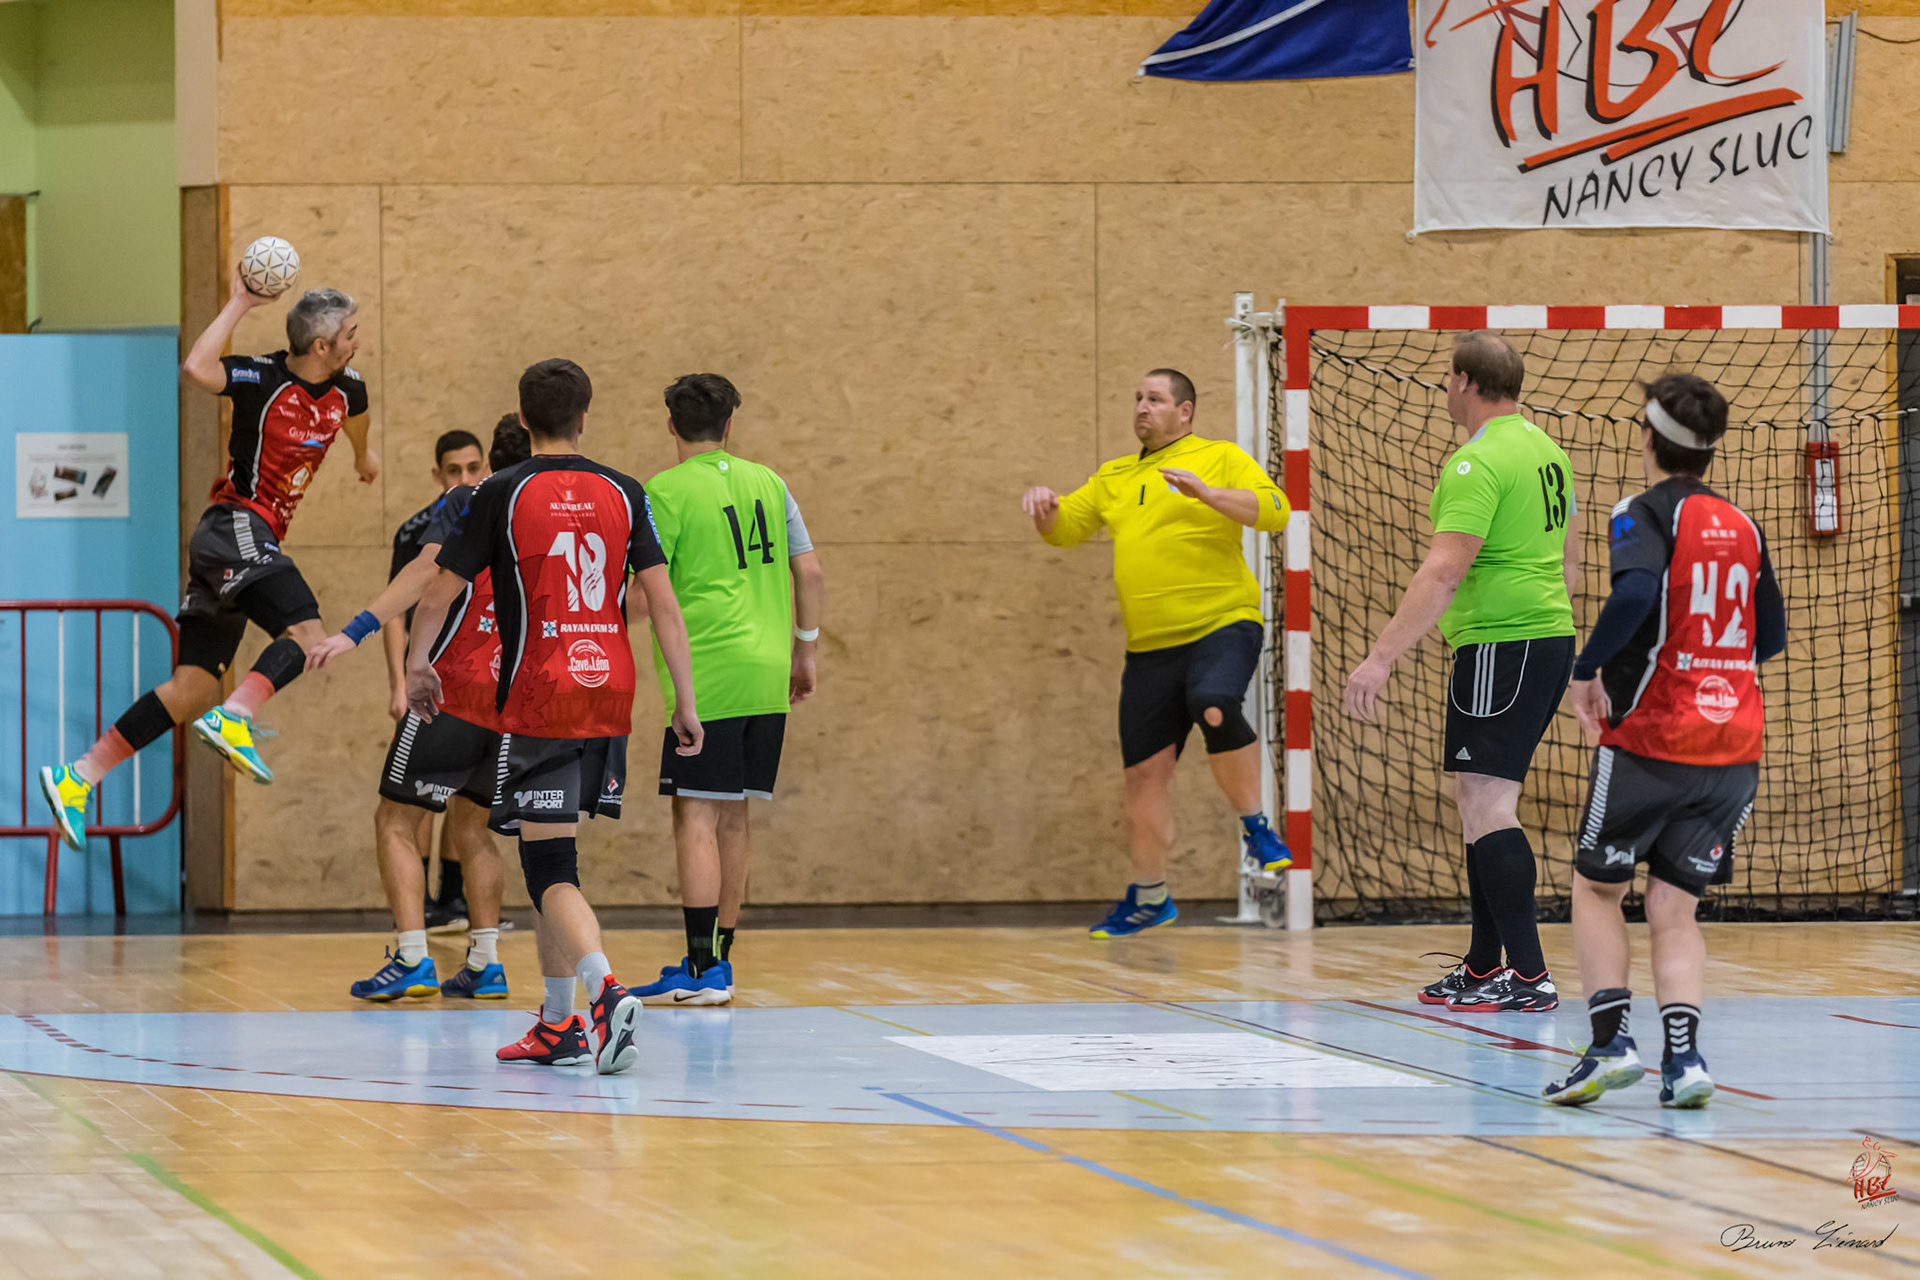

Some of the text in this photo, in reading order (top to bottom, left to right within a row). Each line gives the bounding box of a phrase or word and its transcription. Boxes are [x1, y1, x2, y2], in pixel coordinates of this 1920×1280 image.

[1542, 114, 1814, 226] NANCY SLUC
[1139, 484, 1146, 506] 1
[1538, 462, 1567, 532] 13
[722, 499, 775, 570] 14
[547, 531, 607, 612] 18
[1690, 561, 1750, 648] 42
[560, 623, 590, 633] RAYAN
[608, 624, 618, 634] 54
[570, 656, 610, 673] Cave Léon
[433, 784, 457, 796] INTE
[533, 790, 564, 800] INTER
[533, 800, 563, 809] SPORT
